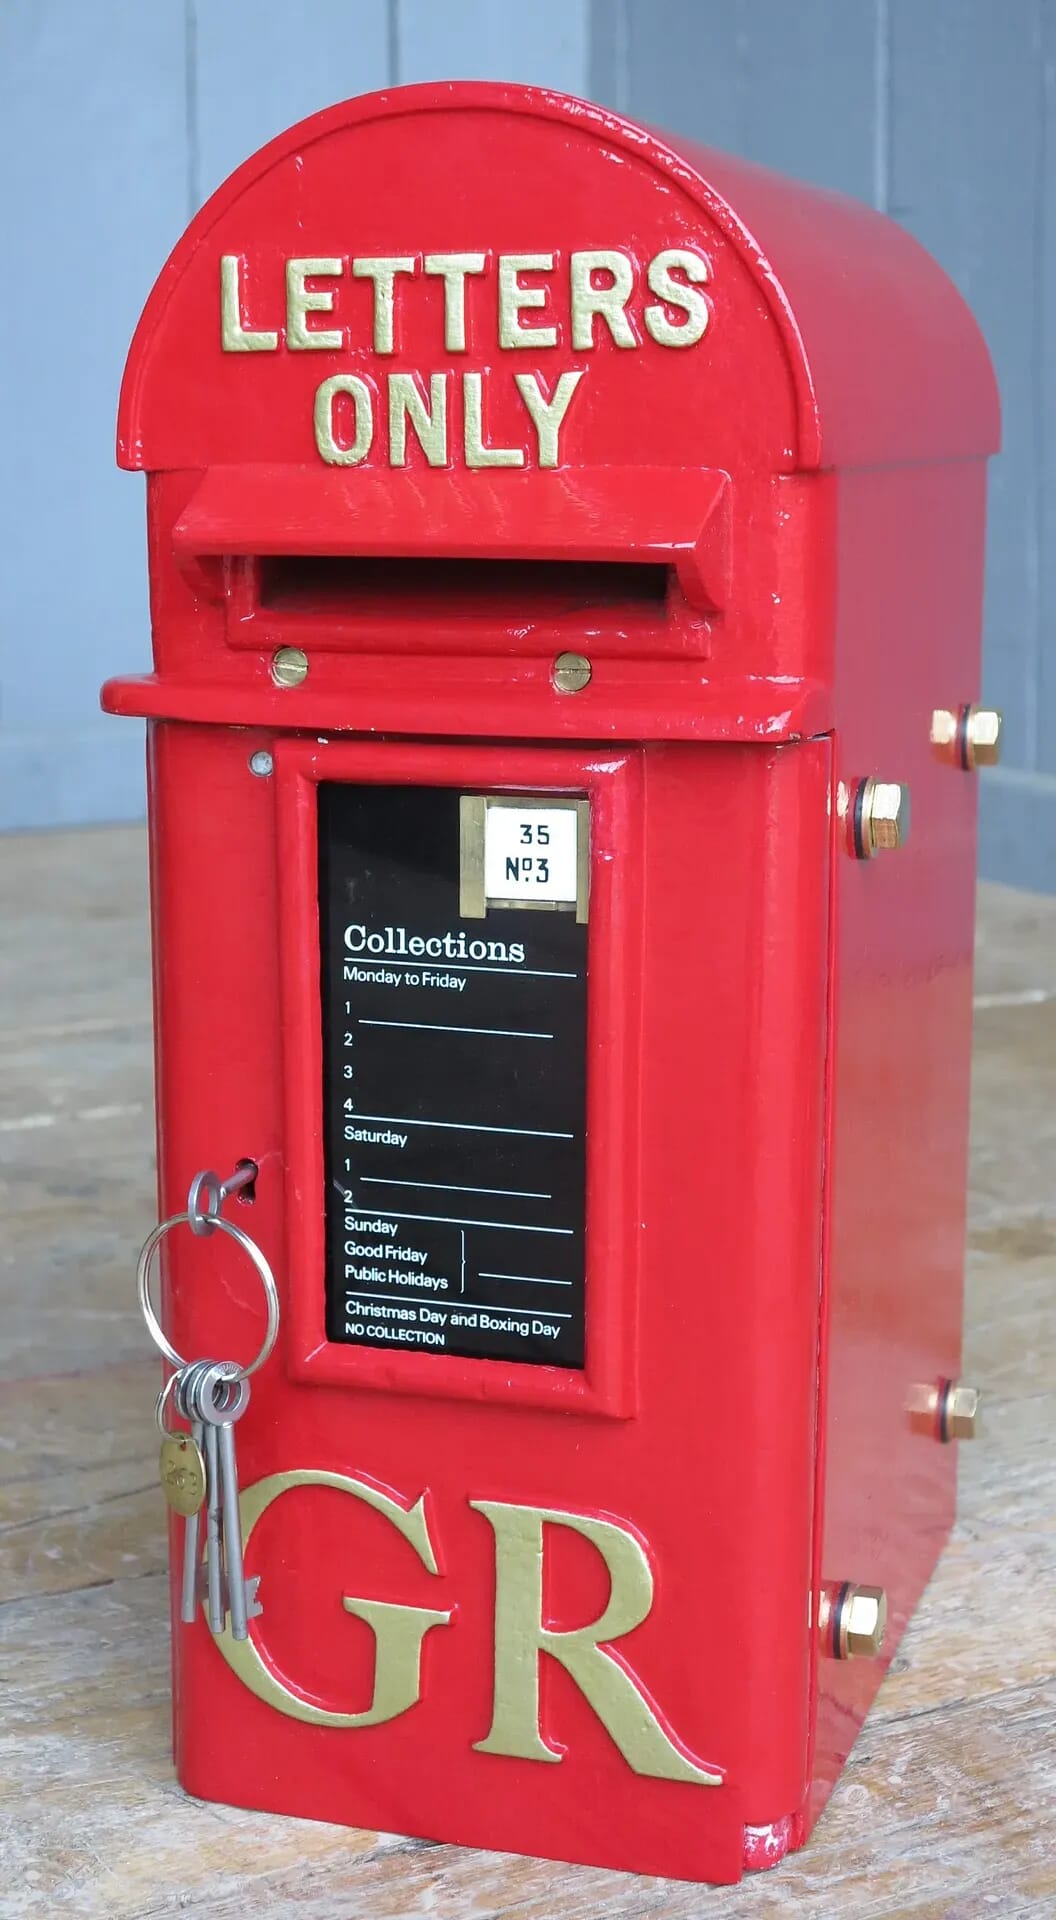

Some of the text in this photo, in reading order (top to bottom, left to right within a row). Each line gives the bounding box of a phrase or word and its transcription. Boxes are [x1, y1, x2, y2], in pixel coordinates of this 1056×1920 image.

[220, 248, 709, 354] LETTERS
[314, 370, 585, 468] ONLY
[520, 824, 550, 844] 35
[344, 925, 525, 963] Collections
[343, 965, 467, 991] Monday to Friday
[345, 1000, 351, 1014] 1
[343, 1032, 353, 1047] 2
[343, 1064, 353, 1079] 3
[343, 1097, 354, 1111] 4
[344, 1126, 408, 1148] Saturday
[344, 1158, 351, 1172] 1
[343, 1189, 353, 1203] 2
[344, 1216, 399, 1237] Sunday
[344, 1240, 428, 1265] Good Friday
[345, 1264, 449, 1291] Public Holidays
[345, 1300, 561, 1340] Christmas Day and Boxing Day
[345, 1323, 445, 1346] NO COLLECTION
[202, 1468, 723, 1786] GR
